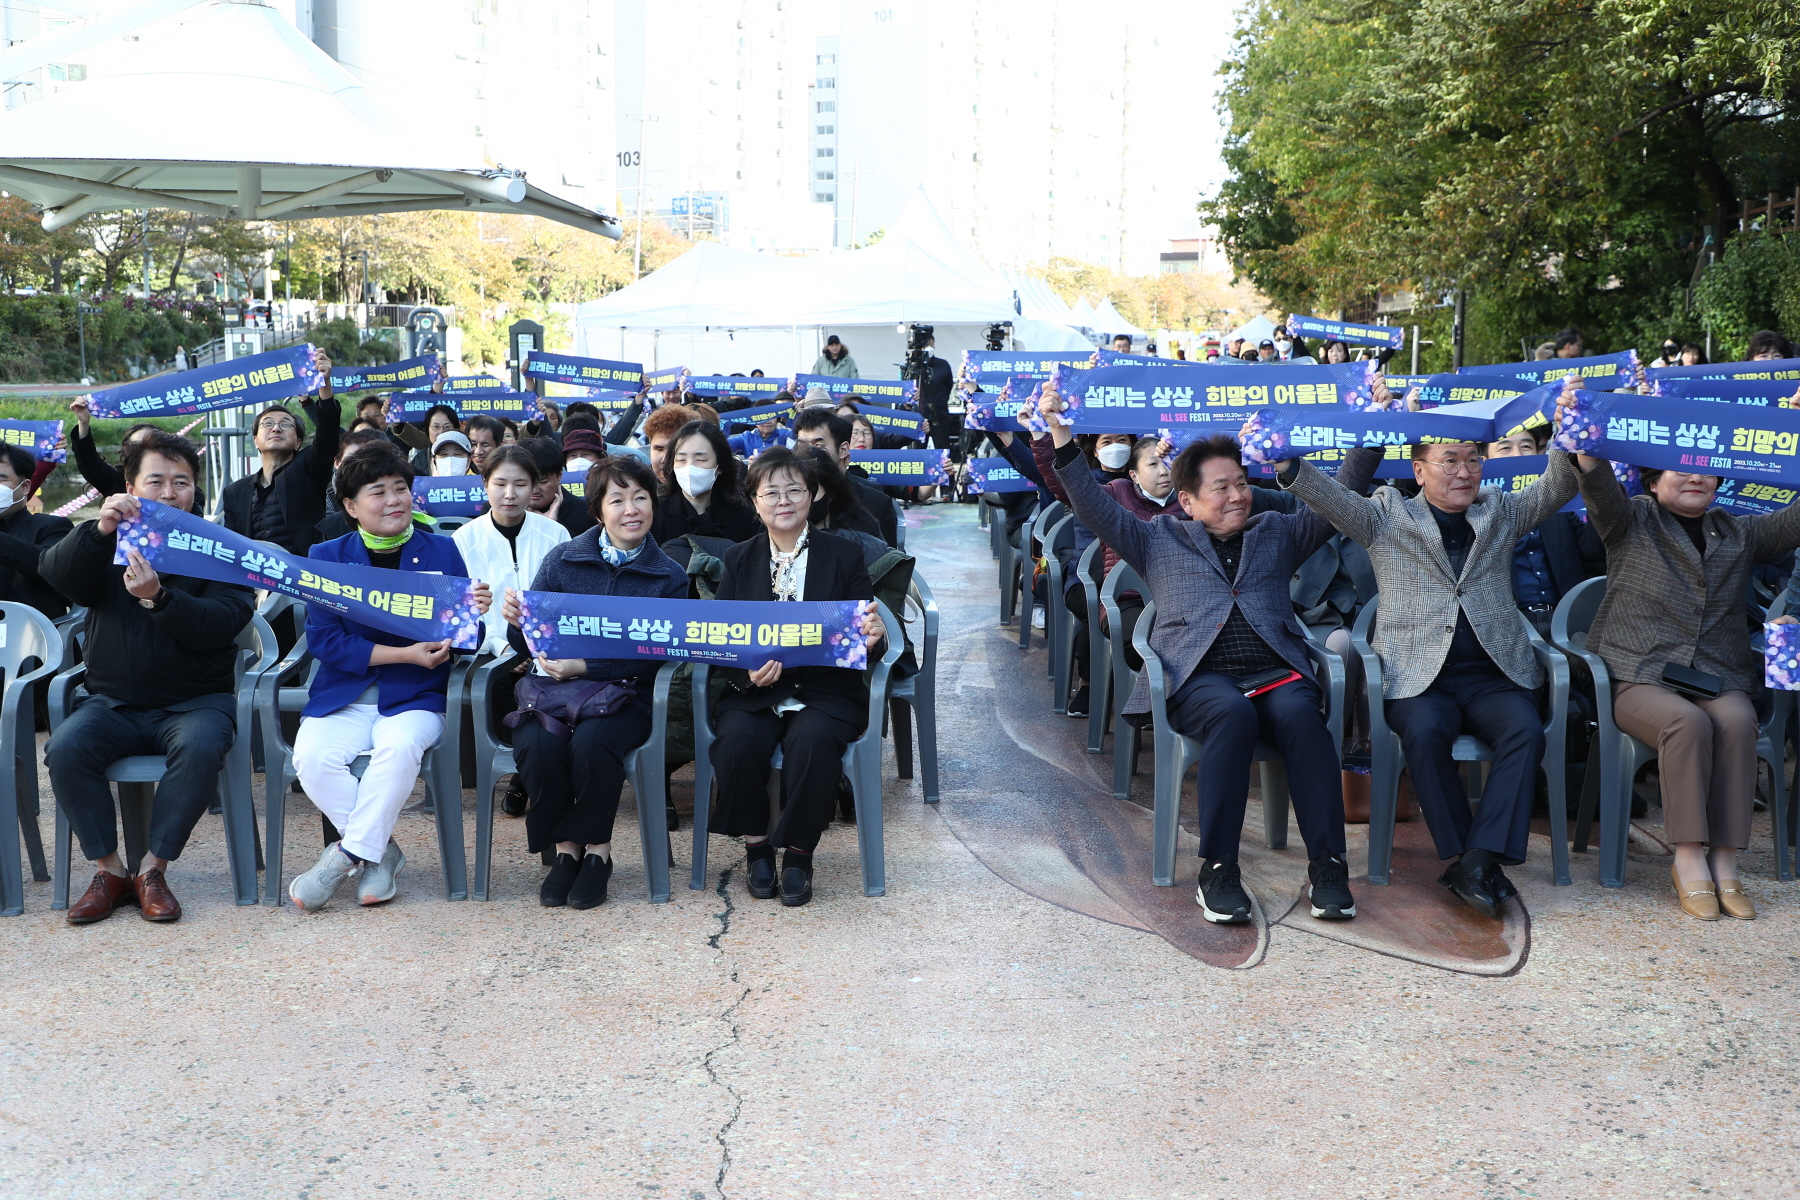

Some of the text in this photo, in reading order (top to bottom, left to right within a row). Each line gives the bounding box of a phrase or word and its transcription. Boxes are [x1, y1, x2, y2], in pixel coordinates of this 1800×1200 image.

[874, 9, 893, 23] 101
[616, 151, 640, 167] 103
[1302, 322, 1325, 332] 설레는
[1325, 324, 1343, 335] 상상,
[1344, 326, 1367, 338] 희망의
[1367, 330, 1390, 341] 어울림
[557, 364, 580, 378] 상상,
[582, 366, 611, 379] 희망의
[612, 370, 642, 382] 어울림
[981, 360, 1012, 372] 설레는
[1013, 361, 1038, 373] 상상,
[1581, 363, 1617, 378] 어울림
[344, 375, 366, 387] 상상,
[366, 373, 396, 382] 희망의
[398, 365, 426, 381] 어울림
[119, 395, 164, 415] 설레는
[165, 385, 202, 406] 상상,
[201, 374, 248, 398] 희망의
[249, 363, 295, 387] 어울림
[453, 380, 476, 389] 희망의
[477, 379, 501, 388] 어울림
[694, 381, 778, 392] 설레는 상상, 희망의 어울림
[832, 383, 851, 393] 상상,
[853, 384, 877, 395] 희망의
[878, 386, 903, 396] 어울림
[1084, 383, 1338, 411] 설레는 상상, 희망의 어울림
[1447, 388, 1487, 401] 희망의
[461, 400, 491, 411] 희망의
[493, 400, 523, 411] 어울림
[892, 418, 918, 430] 어울림
[1160, 413, 1173, 422] ALL
[1175, 413, 1188, 422] SEE
[1189, 412, 1211, 422] FESTA
[1290, 425, 1357, 449] 설레는
[1606, 417, 1799, 456] 설레는 상상, 희망의
[887, 461, 924, 475] 어울림
[1680, 454, 1694, 466] ALL
[1695, 455, 1709, 467] SEE
[1710, 456, 1732, 469] FESTA
[987, 468, 1020, 481] 설레는
[1262, 466, 1273, 474] ALL
[427, 488, 467, 503] 설레는
[1737, 482, 1797, 504] 희망의
[1715, 496, 1735, 506] FESTA
[167, 529, 236, 564] 설레는
[240, 549, 292, 585] 상상,
[298, 569, 363, 602] 희망의
[368, 589, 434, 621] 어울림
[247, 572, 260, 582] ALL
[263, 577, 276, 587] SEE
[278, 583, 300, 595] FESTA
[557, 615, 822, 647] 설레는 상상, 희망의 어울림
[637, 645, 651, 654] ALL
[652, 647, 666, 655] SEE
[667, 648, 689, 657] FESTA
